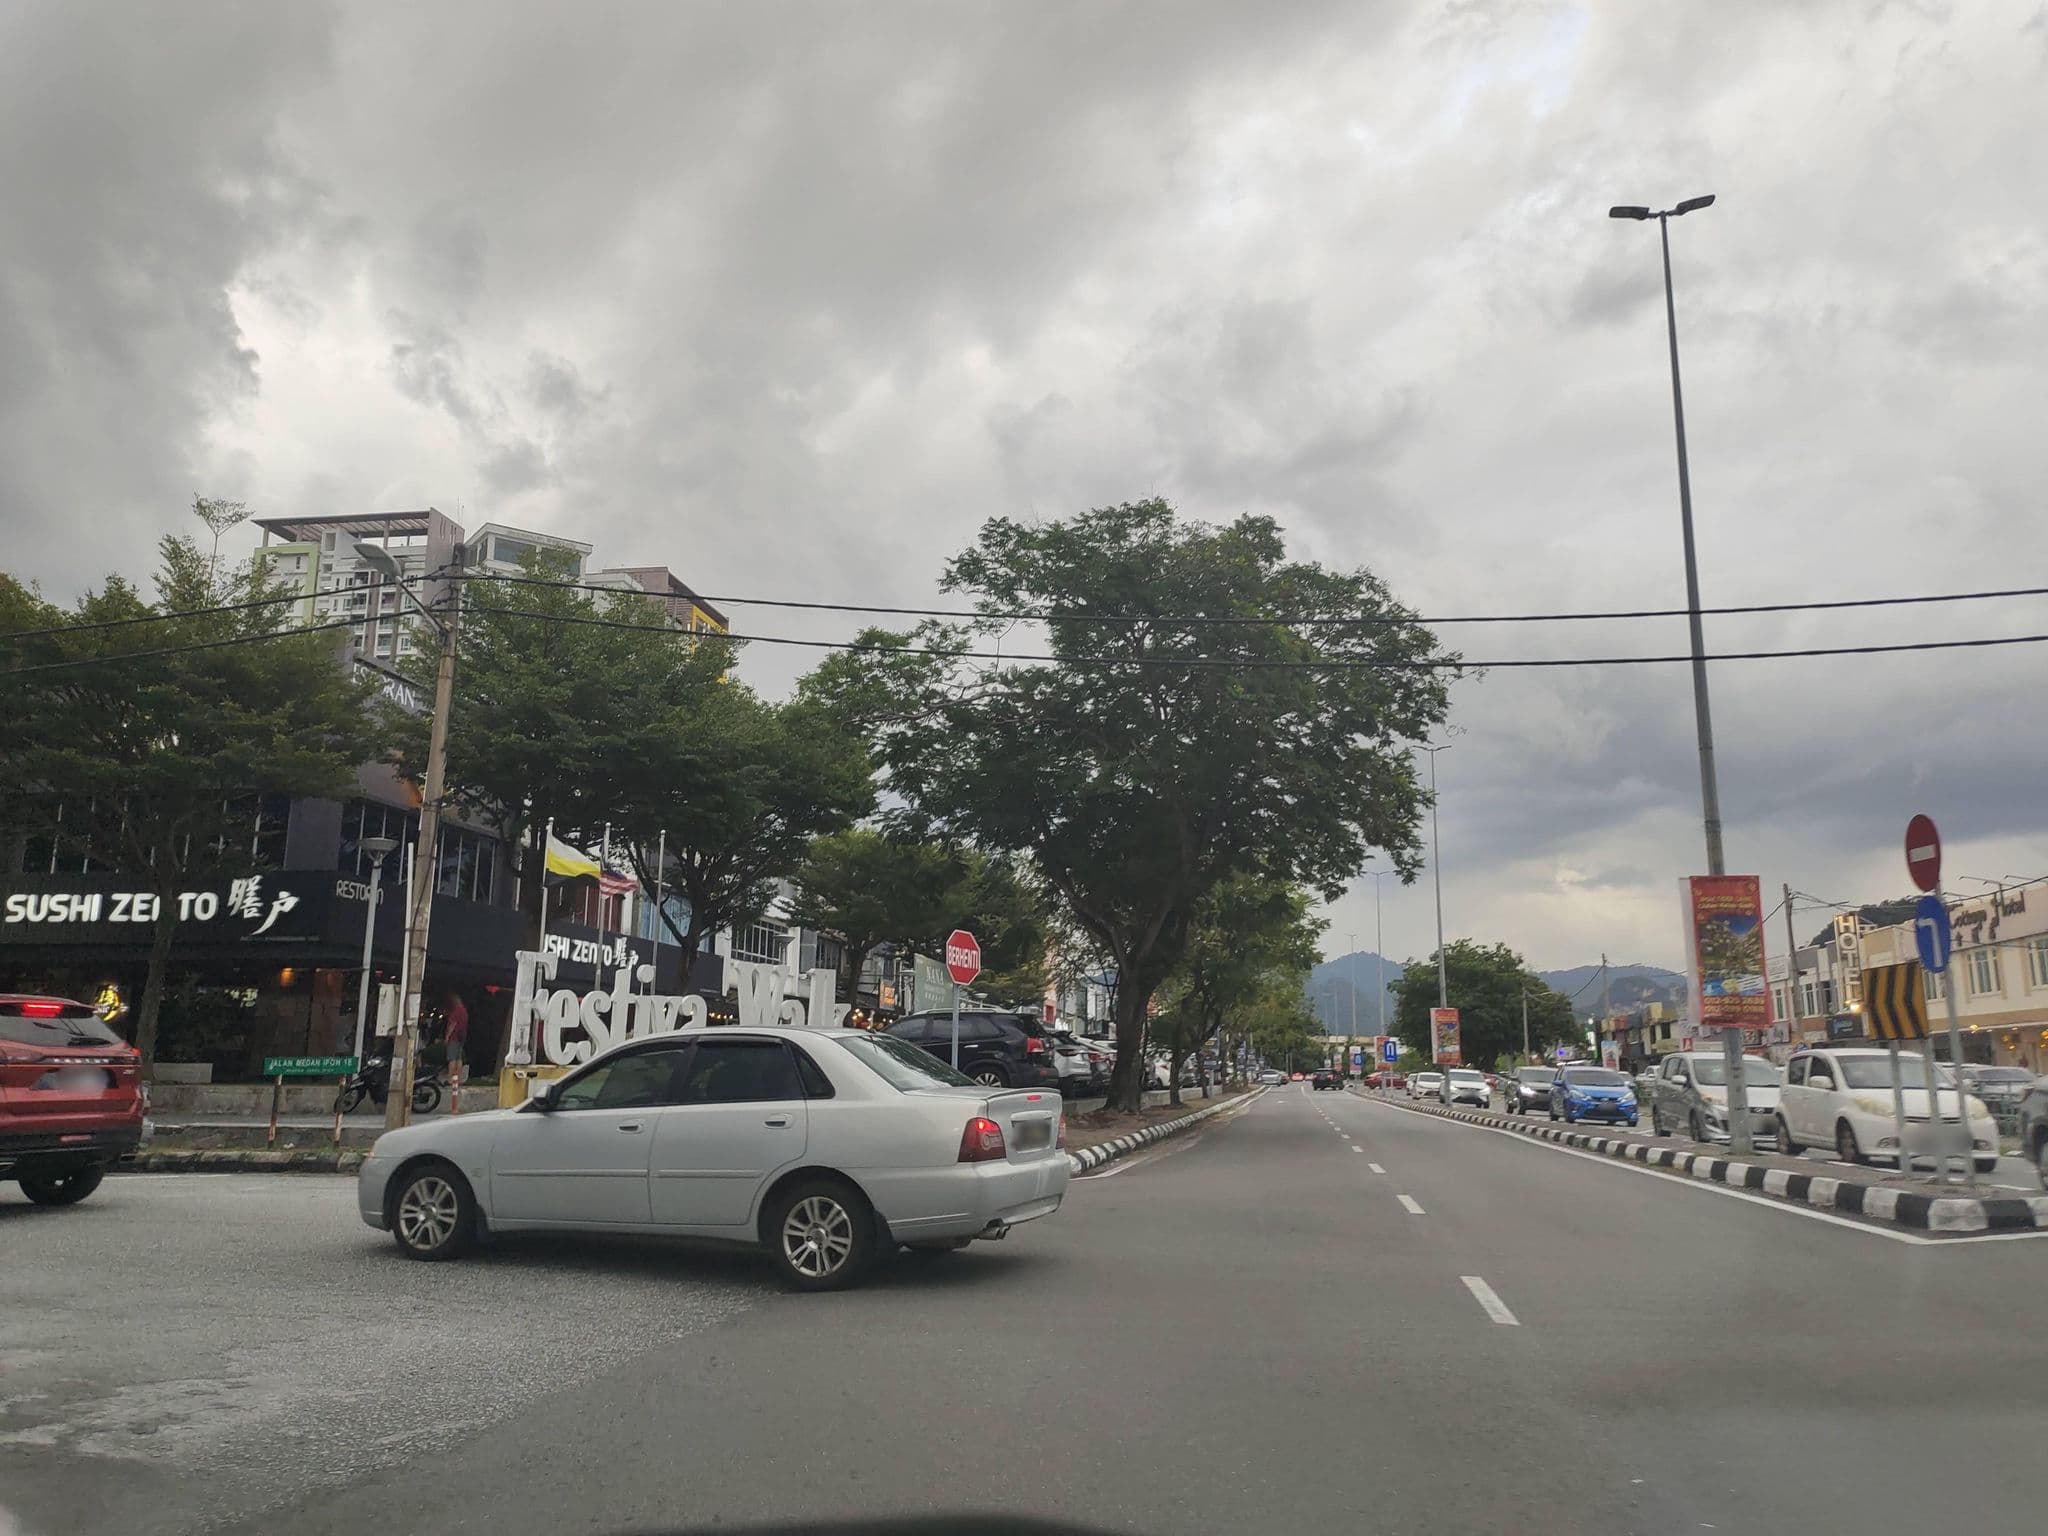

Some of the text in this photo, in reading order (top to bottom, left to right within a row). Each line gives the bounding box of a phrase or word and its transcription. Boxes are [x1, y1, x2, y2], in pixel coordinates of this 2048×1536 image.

[336, 880, 384, 905] RESTORN
[5, 893, 103, 923] SUSHI
[571, 939, 613, 967] ZENO
[948, 945, 978, 970] BERHENTI
[268, 1058, 293, 1070] JALAN
[295, 1057, 321, 1067] MEDAN
[323, 1057, 341, 1067] IPOH
